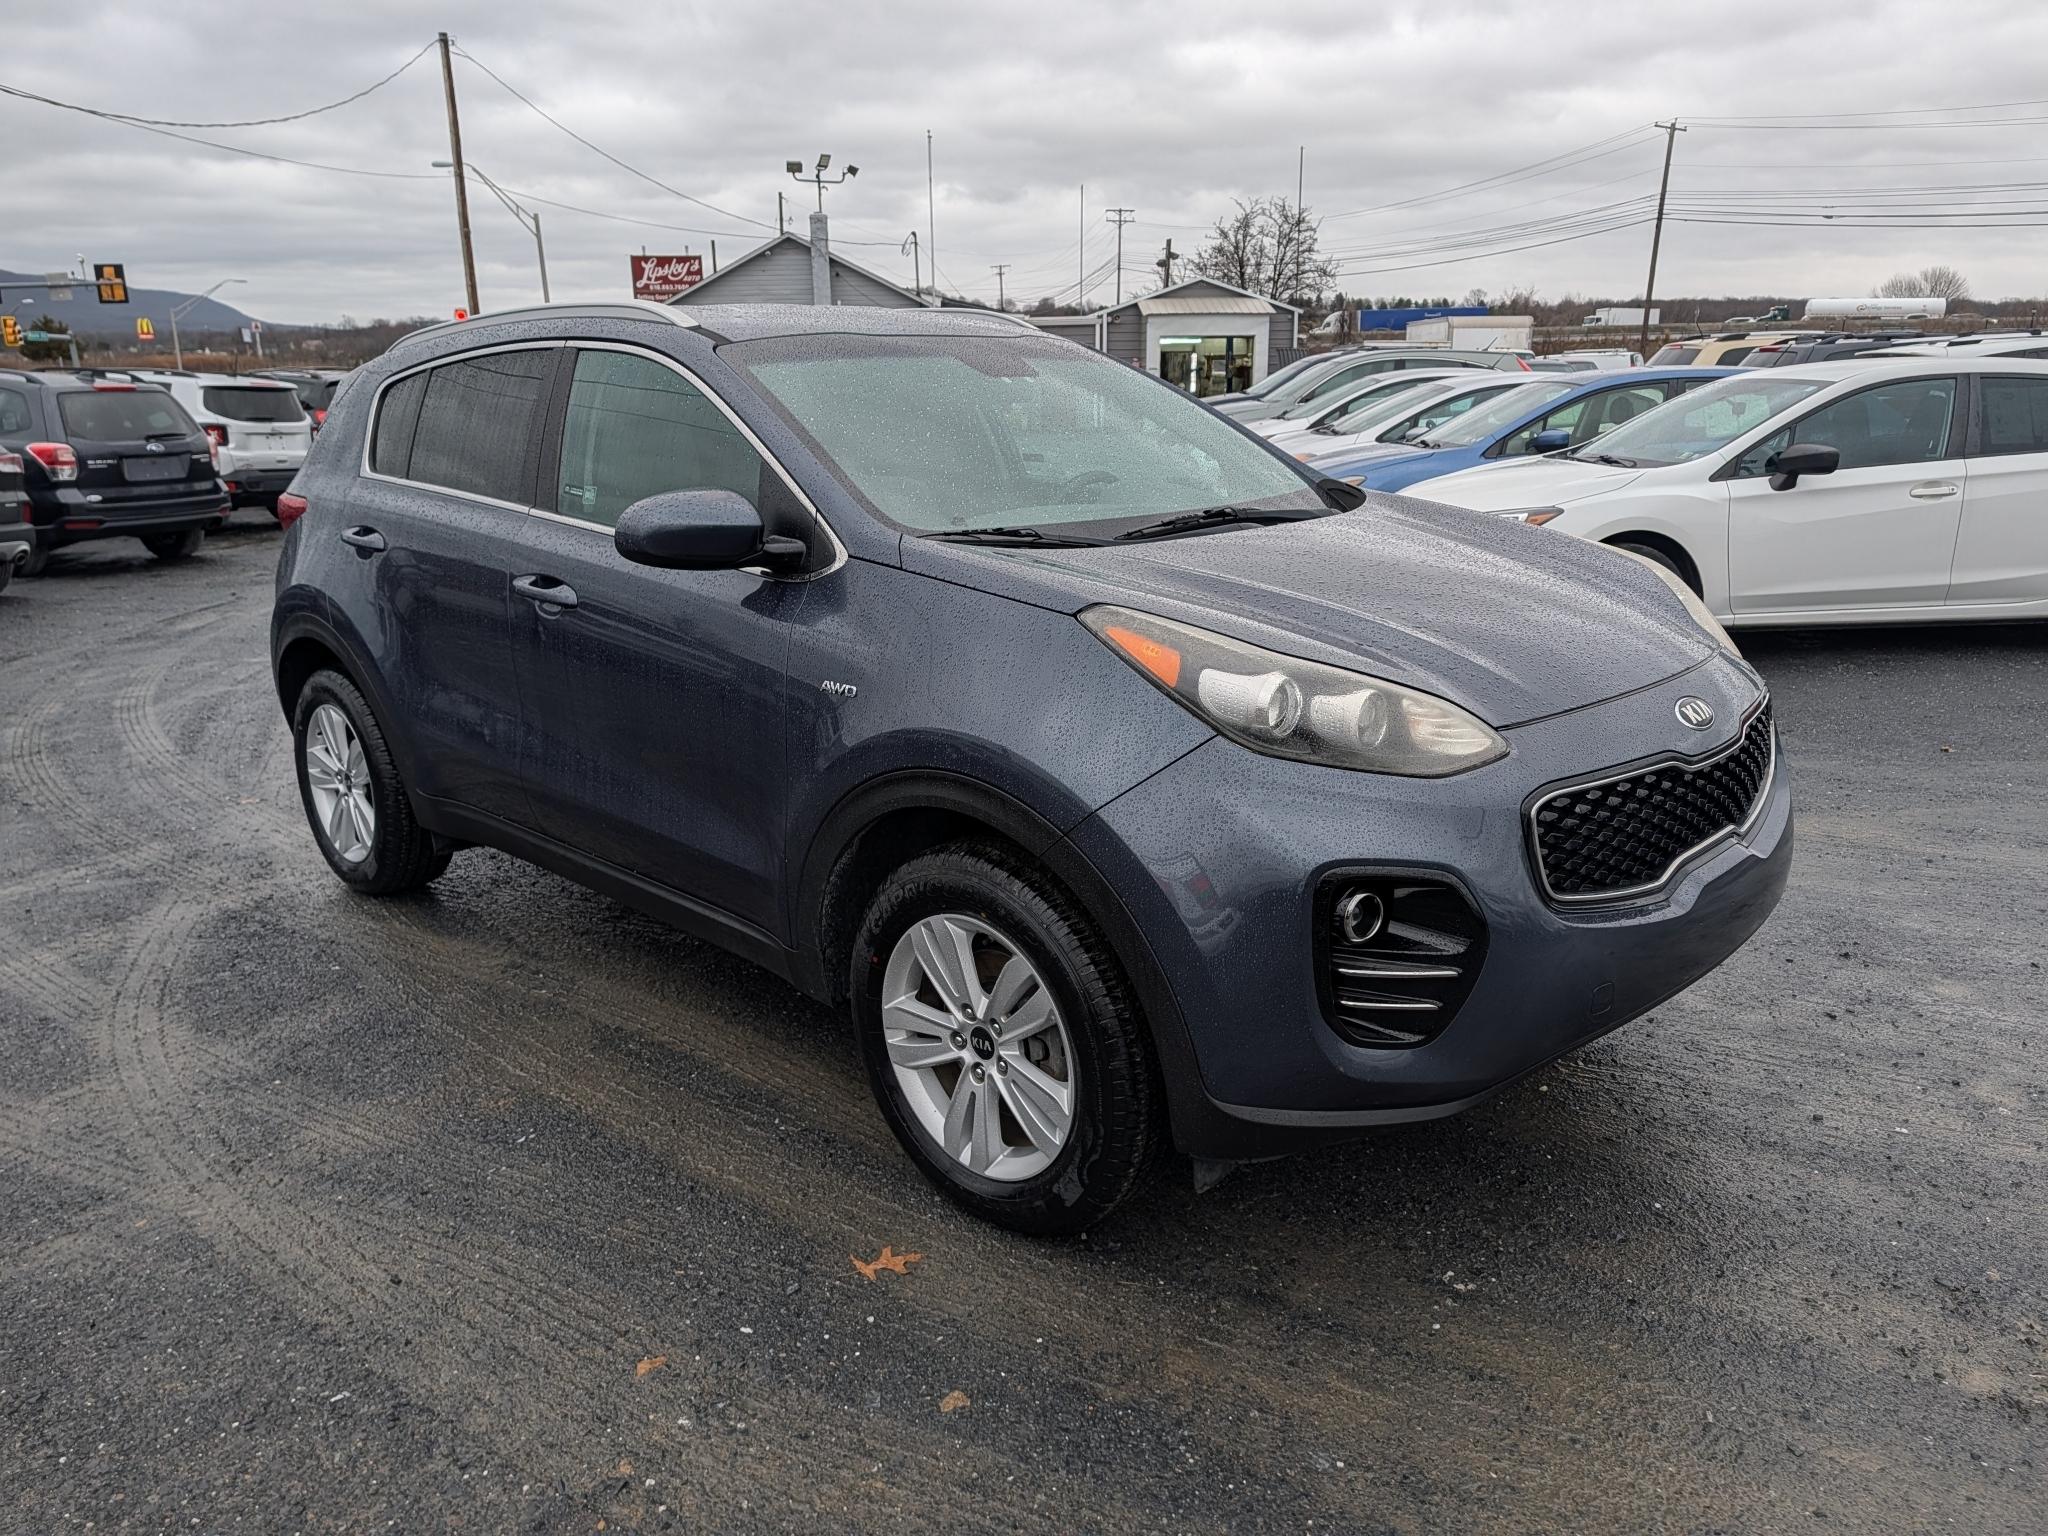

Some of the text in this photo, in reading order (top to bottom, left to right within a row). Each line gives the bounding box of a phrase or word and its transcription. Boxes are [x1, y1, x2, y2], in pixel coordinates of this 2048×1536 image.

[636, 258, 700, 288] Lipsky's
[820, 680, 857, 698] AWD
[972, 1036, 992, 1052] KIA
